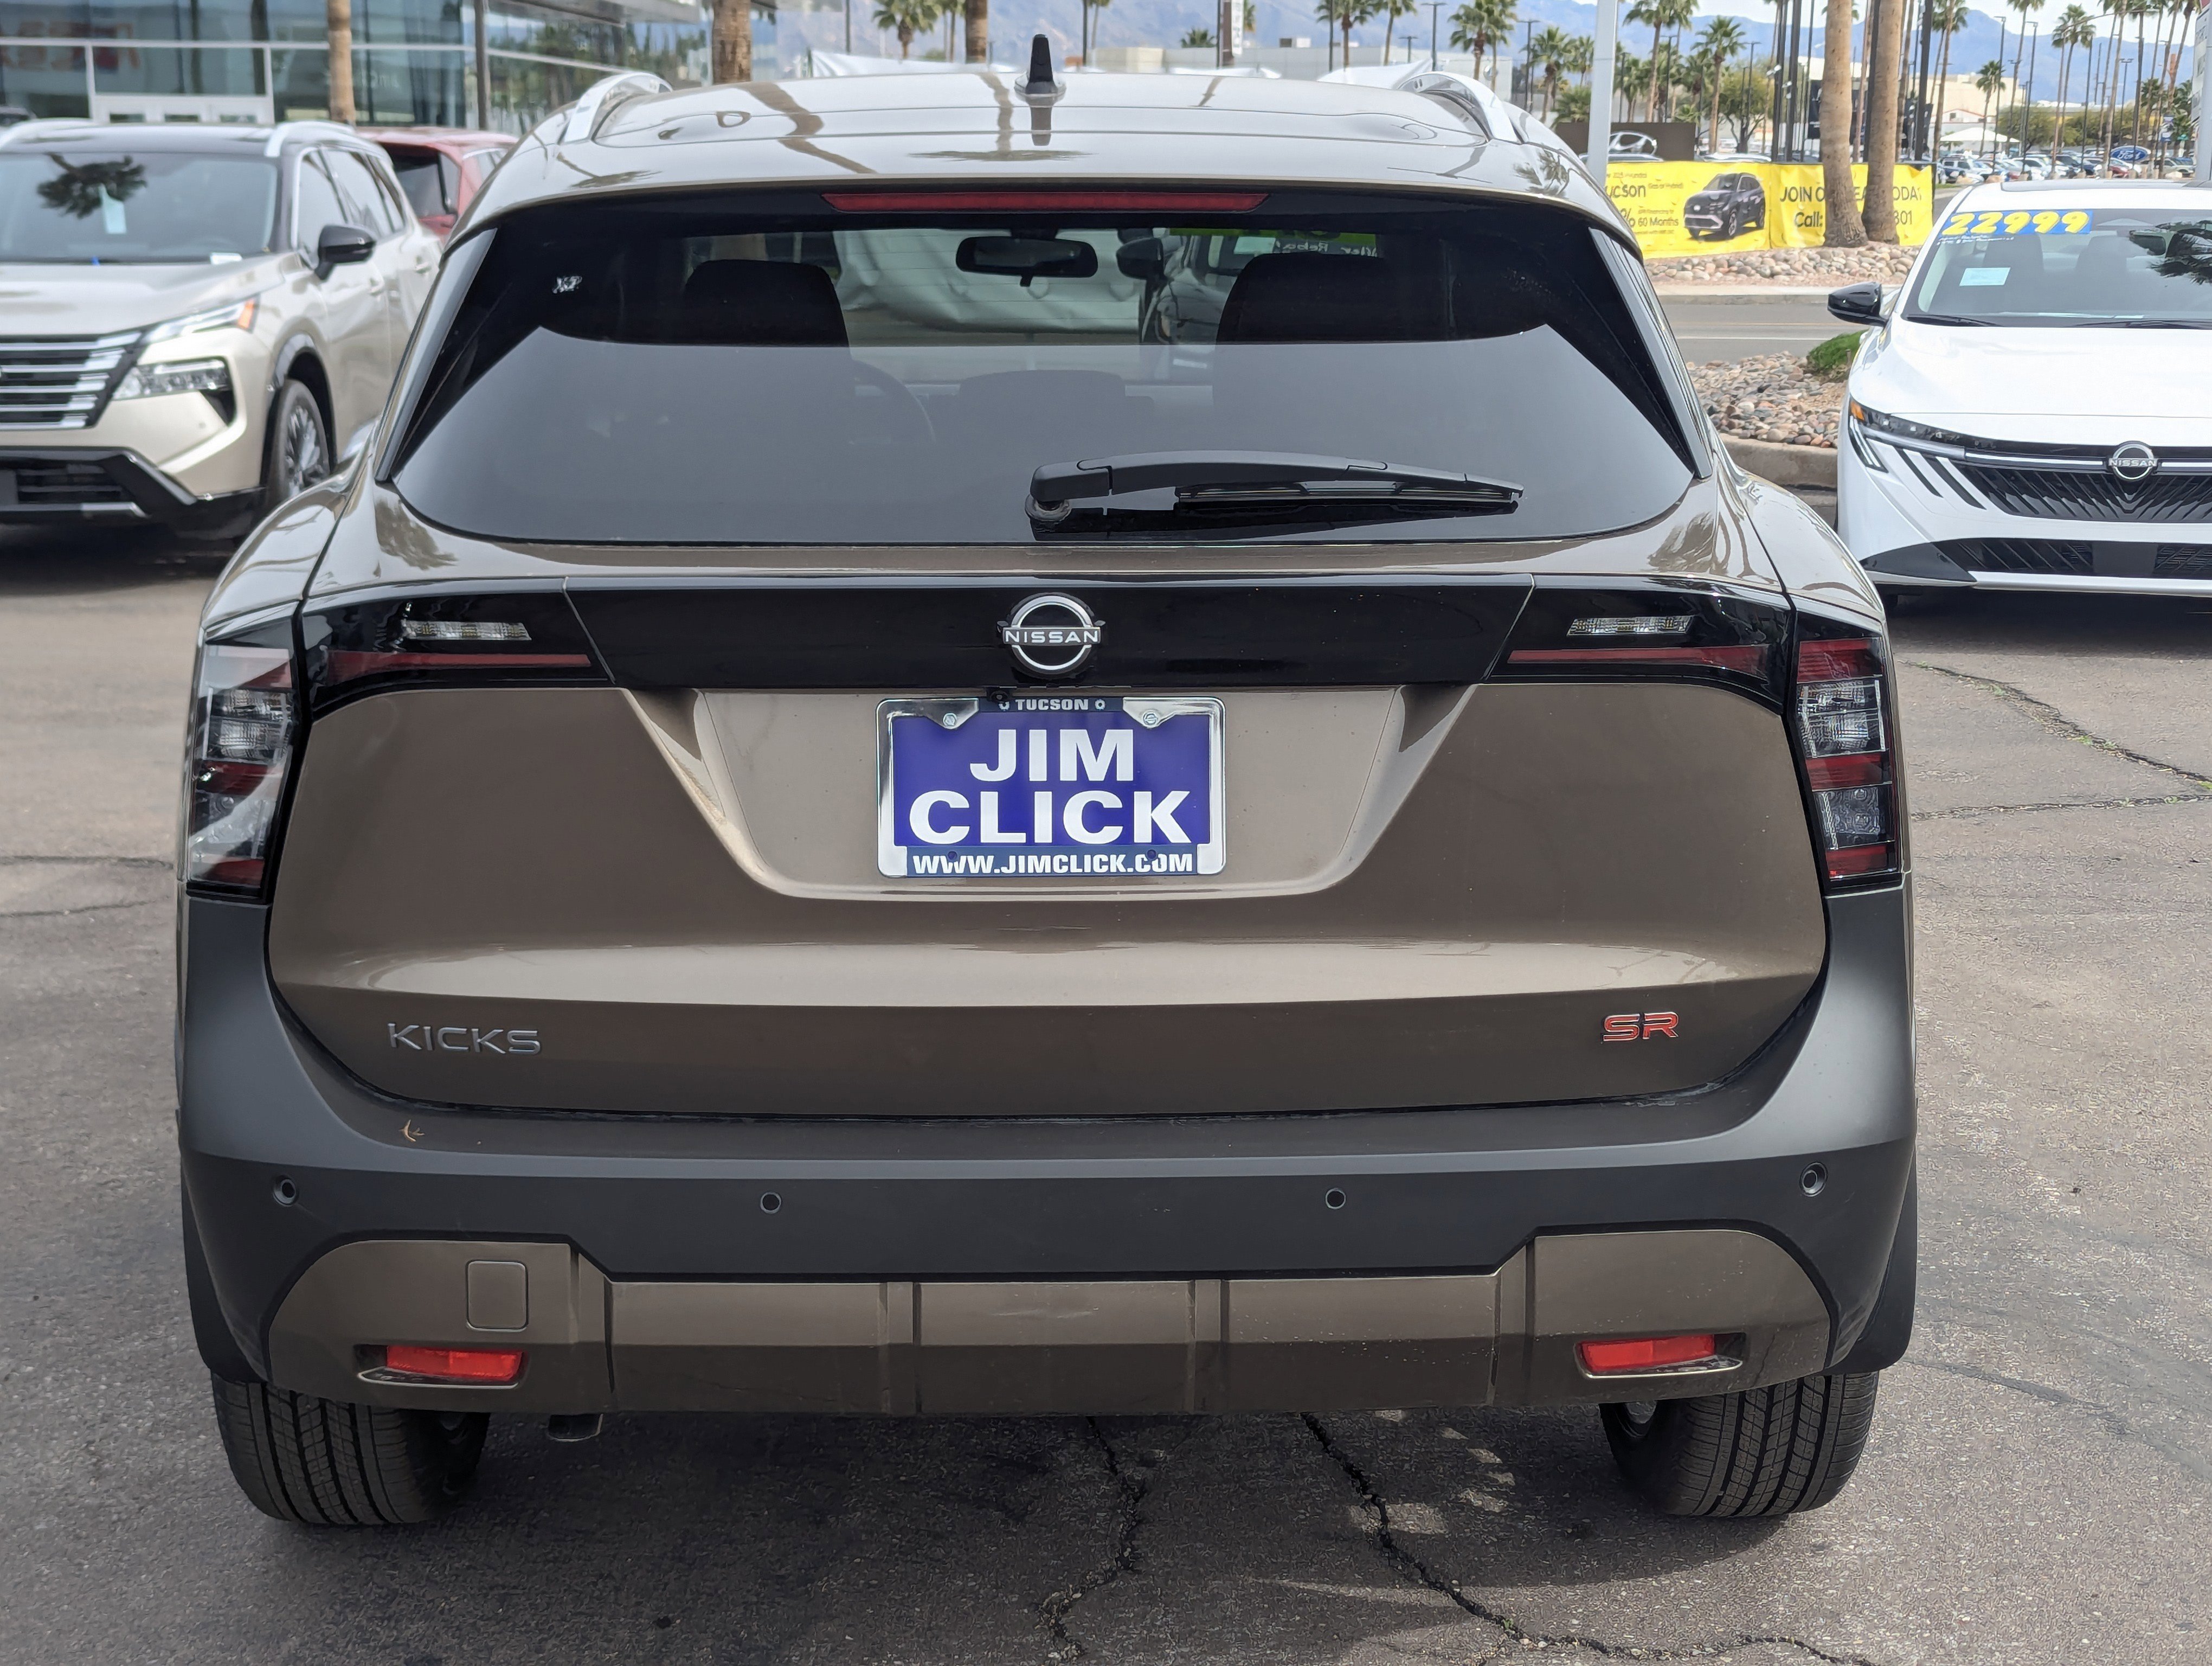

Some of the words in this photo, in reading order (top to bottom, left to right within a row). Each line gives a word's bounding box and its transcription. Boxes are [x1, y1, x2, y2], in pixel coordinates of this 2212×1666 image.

[1780, 186, 1812, 202] JOIN
[1638, 217, 1648, 227] 60
[1794, 210, 1823, 228] Call:
[1941, 211, 2089, 235] 22999
[2108, 458, 2157, 466] NISSAN
[1005, 630, 1099, 643] NISSAN
[1015, 699, 1089, 710] TUCSON
[969, 729, 1134, 782] JIM
[909, 790, 1191, 844] CLICK
[912, 853, 1193, 874] WWW.JIMCLICK.COM
[1603, 1011, 1679, 1042] SR
[387, 1022, 541, 1055] KICKS
